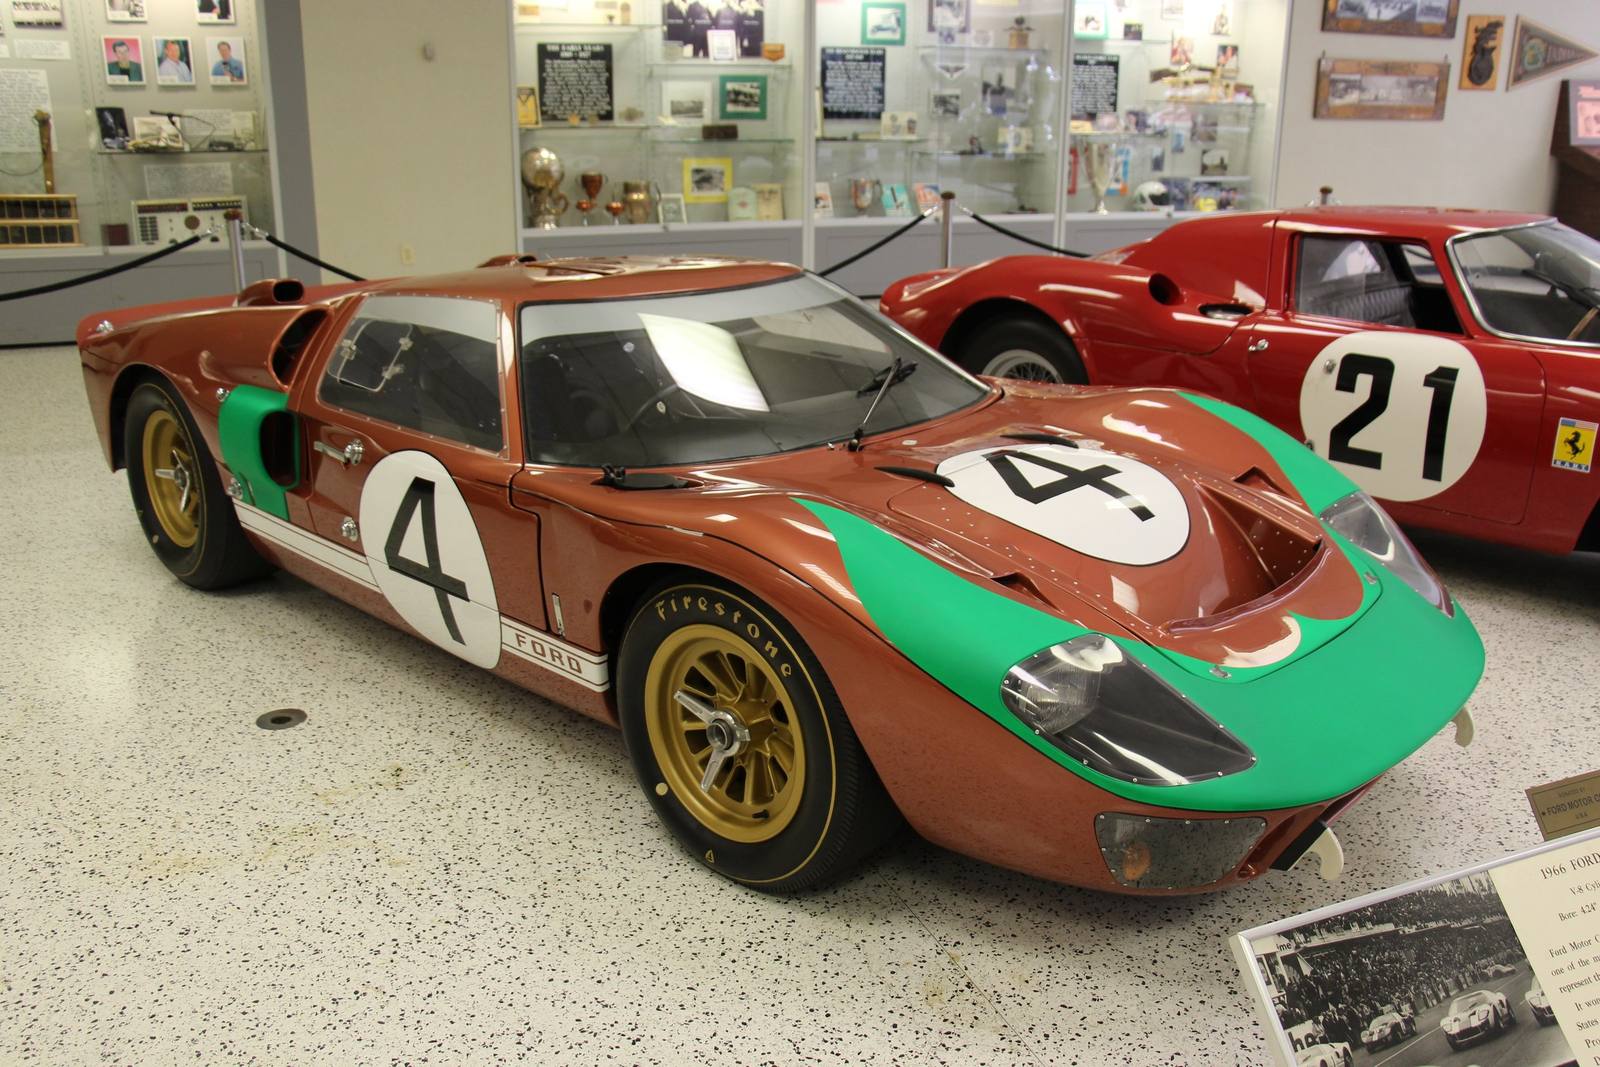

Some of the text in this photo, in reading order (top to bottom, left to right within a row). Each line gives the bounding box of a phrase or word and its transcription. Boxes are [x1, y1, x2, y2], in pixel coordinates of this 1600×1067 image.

[1328, 352, 1460, 483] 21
[981, 449, 1156, 522] 4
[384, 476, 471, 647] 4
[656, 593, 792, 678] Firestone
[515, 632, 583, 675] FORD
[1546, 803, 1567, 816] FORD
[1567, 796, 1593, 810] MOTOR
[1541, 852, 1600, 879] 1966 FORD
[1569, 885, 1584, 895] V-8
[1549, 945, 1568, 958] Ford
[1569, 938, 1592, 951] Motor
[1551, 967, 1564, 977] one
[1567, 960, 1576, 971] of
[1577, 958, 1590, 968] the
[1559, 976, 1593, 993] represent
[1574, 1002, 1583, 1011] It
[1576, 1018, 1599, 1031] States
